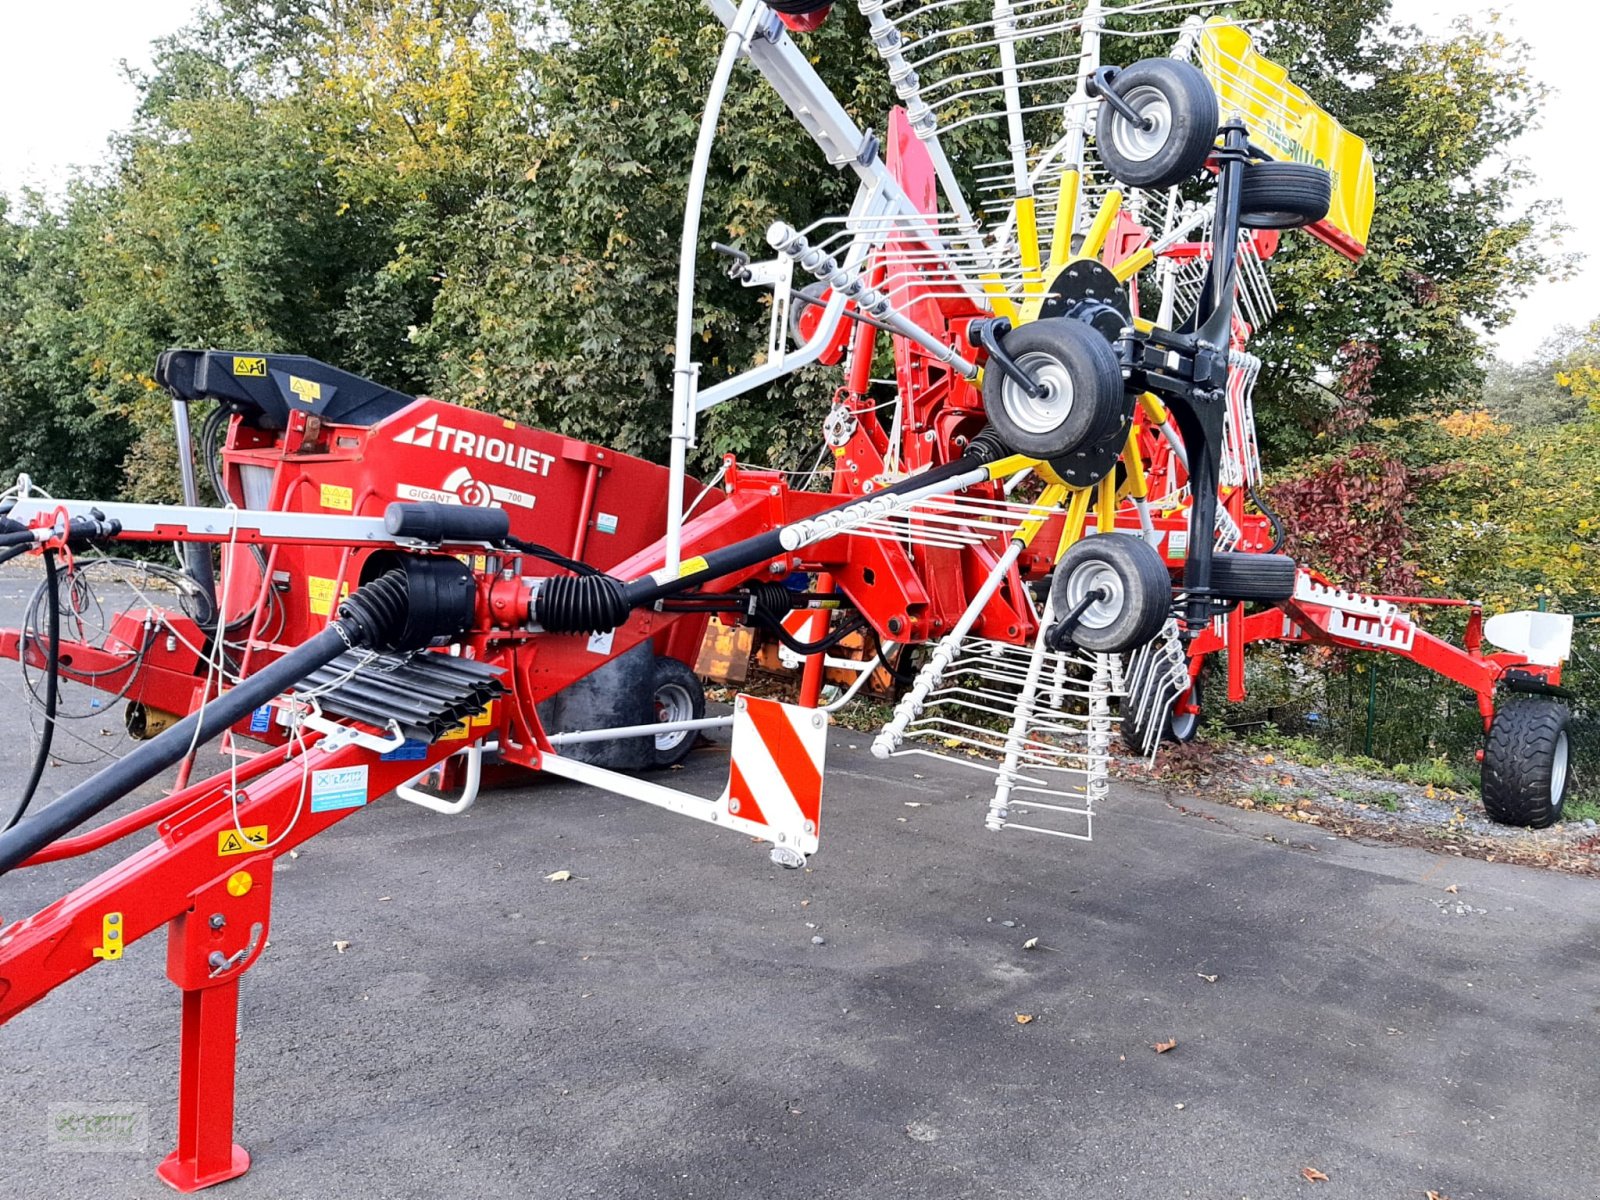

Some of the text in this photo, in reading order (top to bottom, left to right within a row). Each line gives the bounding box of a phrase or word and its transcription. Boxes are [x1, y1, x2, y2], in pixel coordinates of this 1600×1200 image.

[436, 425, 556, 477] TRIOLIET
[408, 488, 522, 503] GIGANT 700
